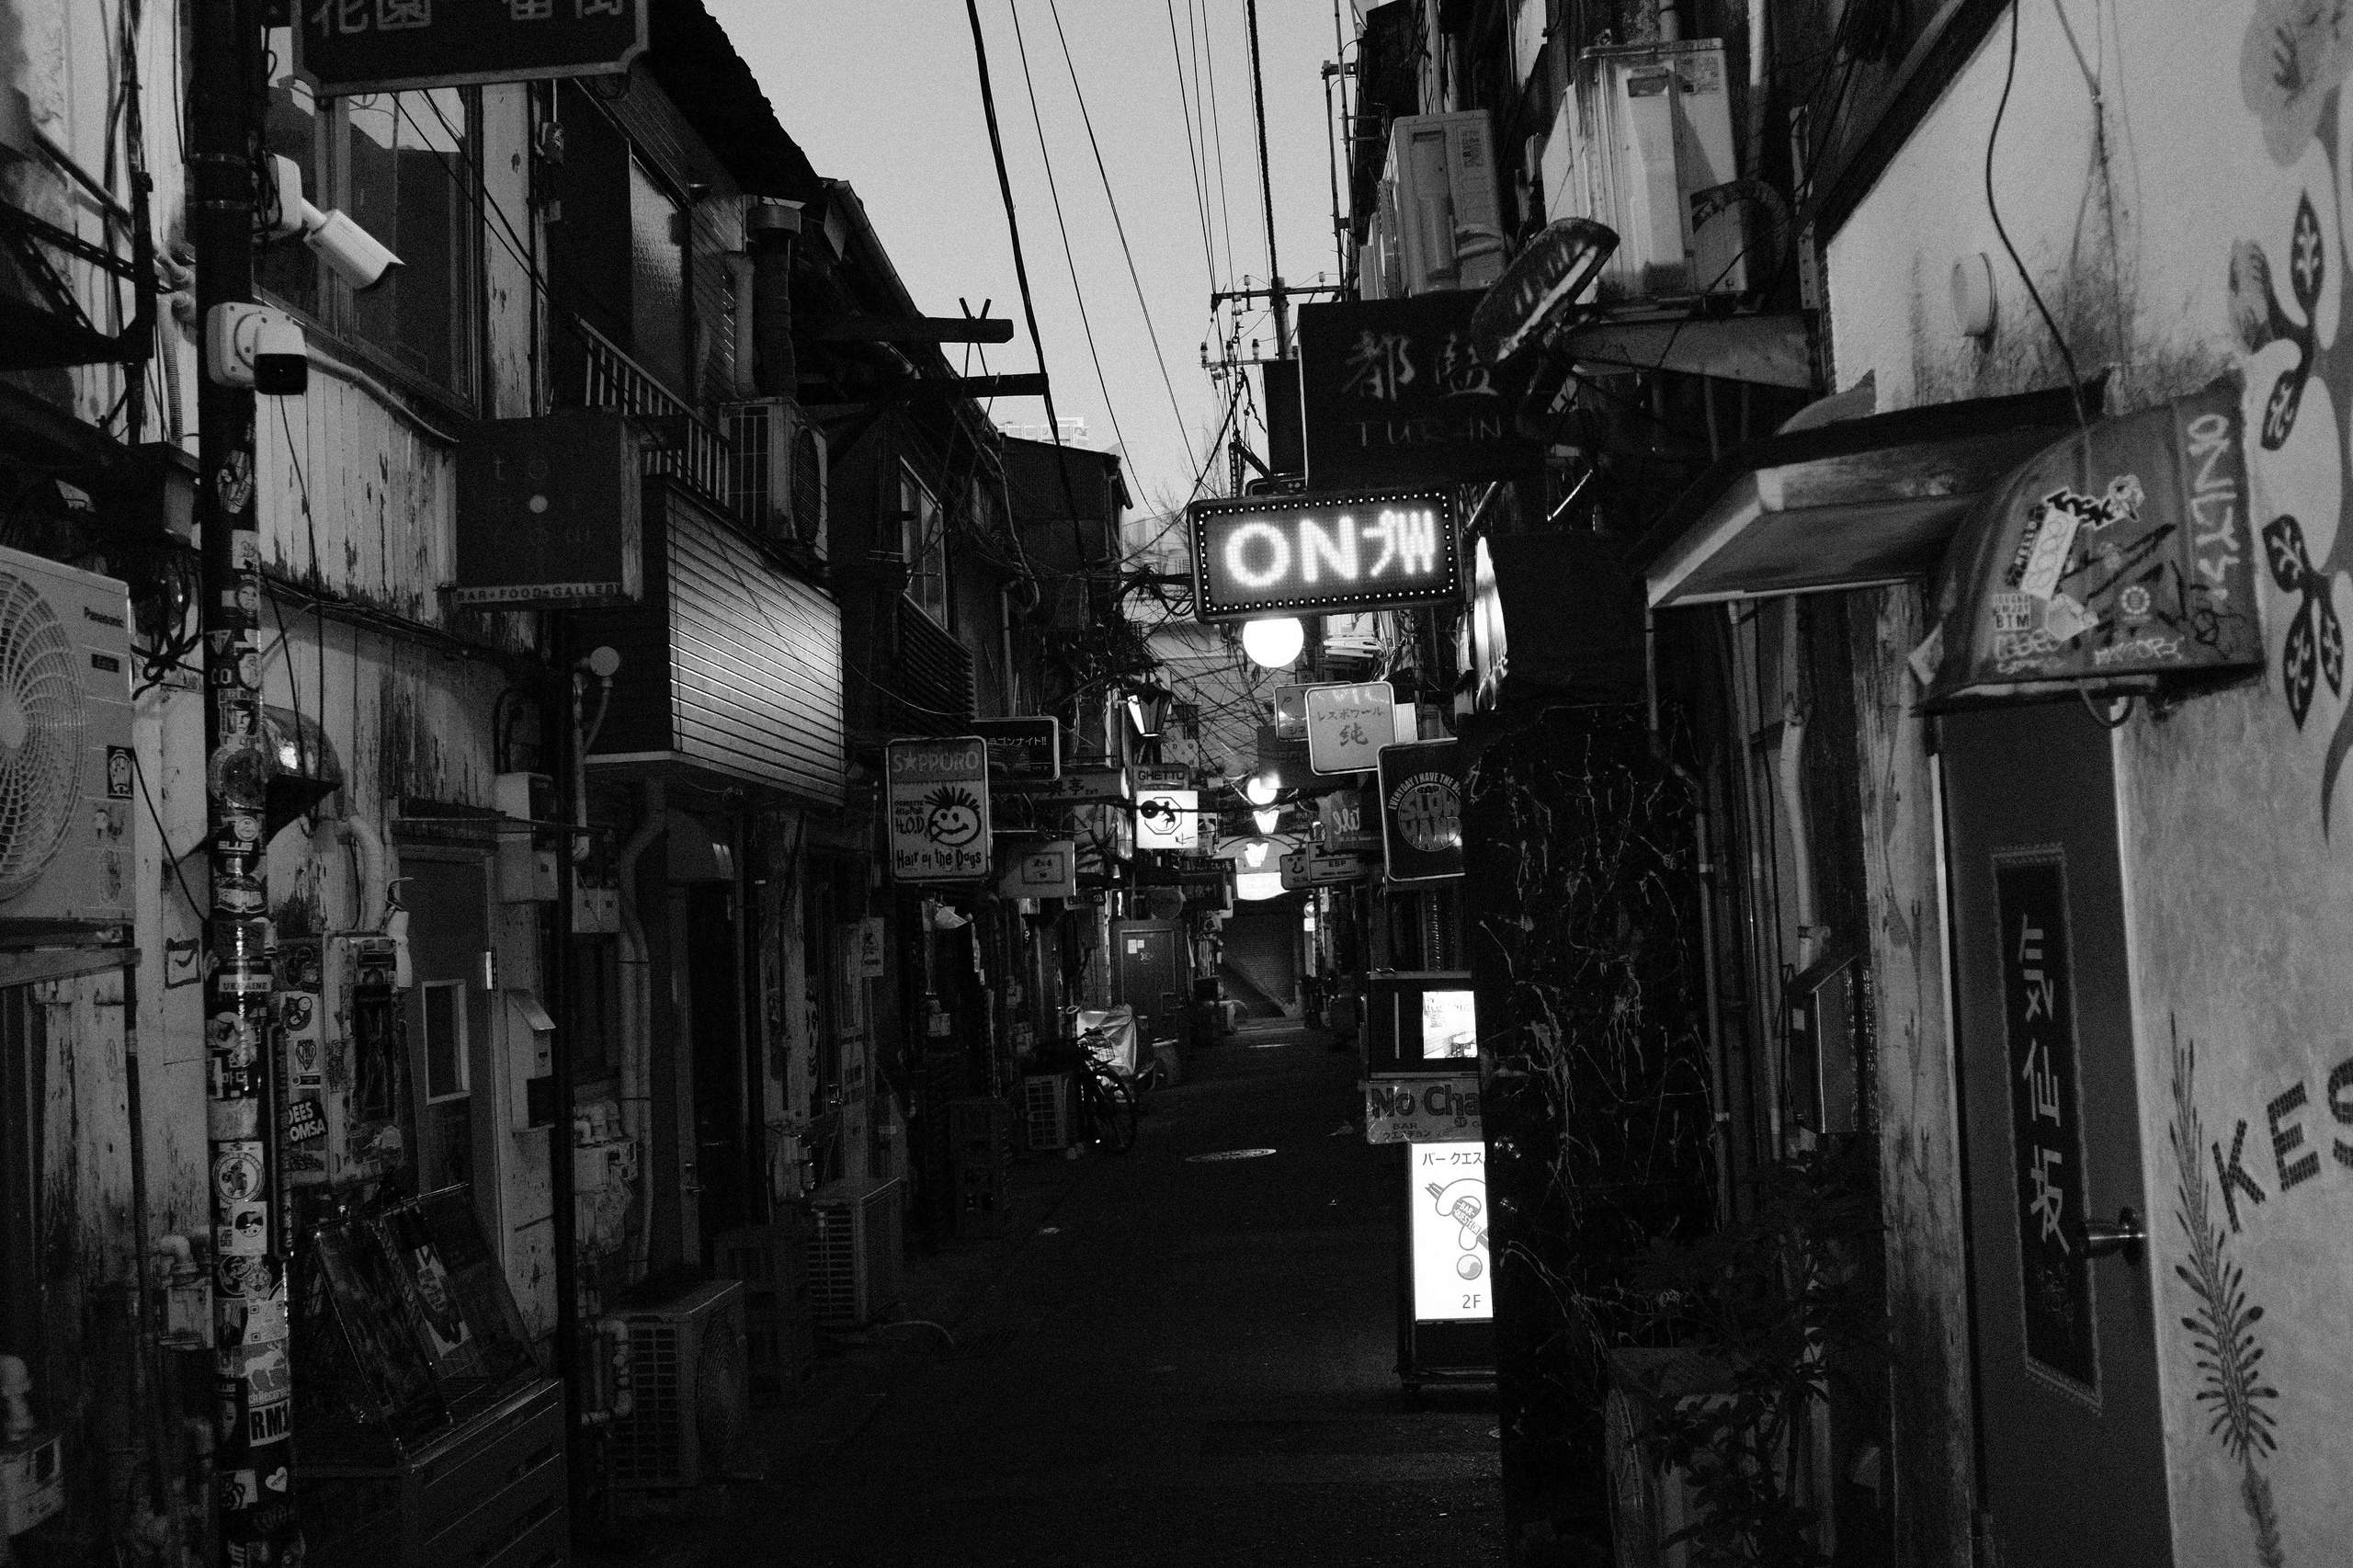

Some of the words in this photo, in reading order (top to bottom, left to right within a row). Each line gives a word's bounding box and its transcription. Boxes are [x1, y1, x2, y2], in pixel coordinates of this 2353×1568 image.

[1138, 770, 1185, 780] GHETTO
[896, 848, 918, 869] Hair
[922, 853, 932, 869] of
[935, 848, 953, 866] the
[956, 848, 982, 869] Dogs
[1371, 1088, 1415, 1119] No
[1423, 1152, 1446, 1165] バー
[1462, 1294, 1481, 1309] 2F
